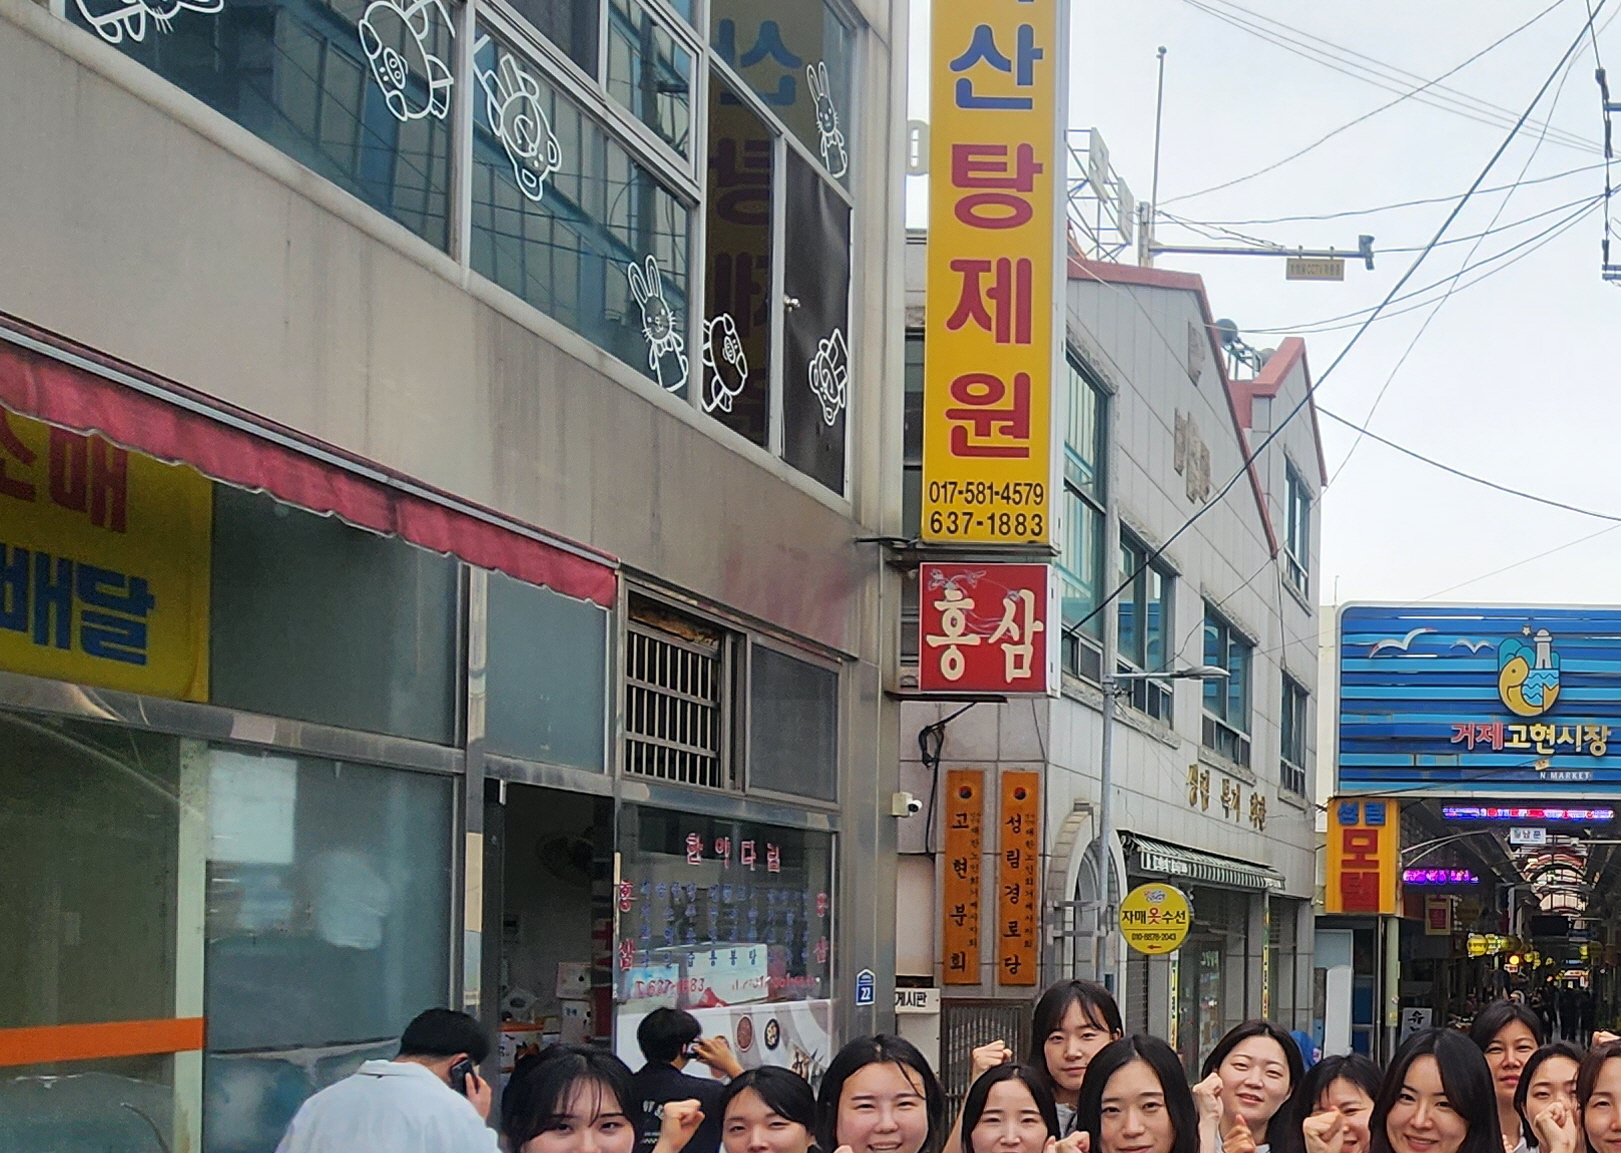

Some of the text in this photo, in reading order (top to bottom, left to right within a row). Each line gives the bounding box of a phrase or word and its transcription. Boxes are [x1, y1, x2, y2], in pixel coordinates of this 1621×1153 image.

[929, 480, 1044, 507] 017-581-4579
[930, 511, 1043, 536] 637-1883
[926, 588, 1044, 684] 홍삼
[1450, 723, 1611, 757] 거제고현시장
[1341, 829, 1380, 912] 모텔
[950, 813, 970, 973] 고현분회
[1004, 814, 1022, 974] 성림경로당
[1122, 907, 1187, 925] 자매옷수선
[860, 987, 870, 1001] 22
